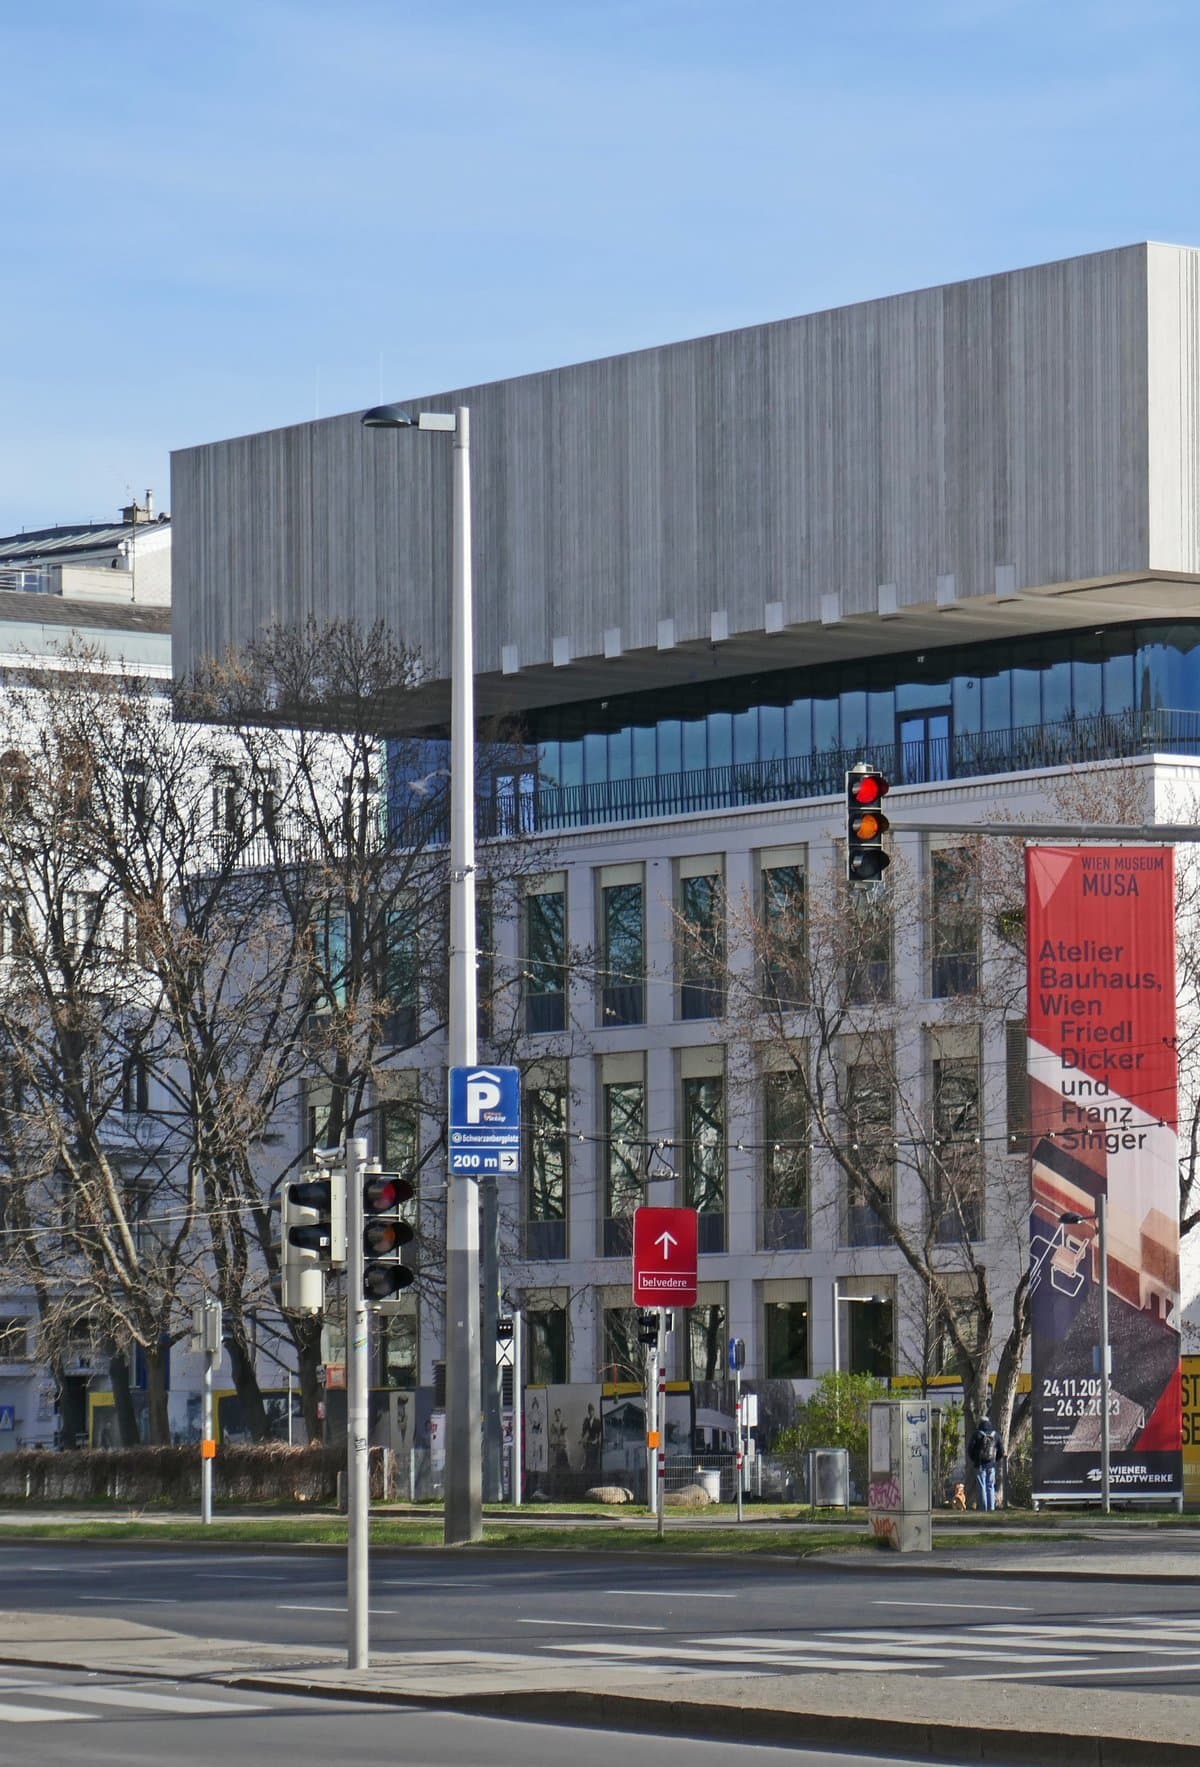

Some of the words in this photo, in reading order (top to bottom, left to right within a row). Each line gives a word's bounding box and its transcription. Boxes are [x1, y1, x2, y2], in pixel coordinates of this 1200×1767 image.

[1081, 856, 1111, 870] WIEN
[1114, 856, 1164, 871] MUSEUM
[1082, 873, 1139, 896] MUSA
[1039, 940, 1124, 962] Atelier
[1040, 967, 1163, 992] Bauhaus,
[1040, 993, 1102, 1016] Wien
[1060, 1020, 1133, 1043] Friedl
[1060, 1047, 1145, 1070] Dicker
[1060, 1075, 1109, 1096] und
[467, 1082, 501, 1124] P
[1061, 1102, 1133, 1124] Franz
[462, 1134, 519, 1144] Schwarzenbergplatz
[1061, 1127, 1147, 1154] Singer
[453, 1154, 480, 1168] 200
[484, 1157, 497, 1168] m
[642, 1276, 687, 1288] belvedere
[1108, 1465, 1147, 1475] WIENER
[1108, 1473, 1174, 1483] STADTWERKE
